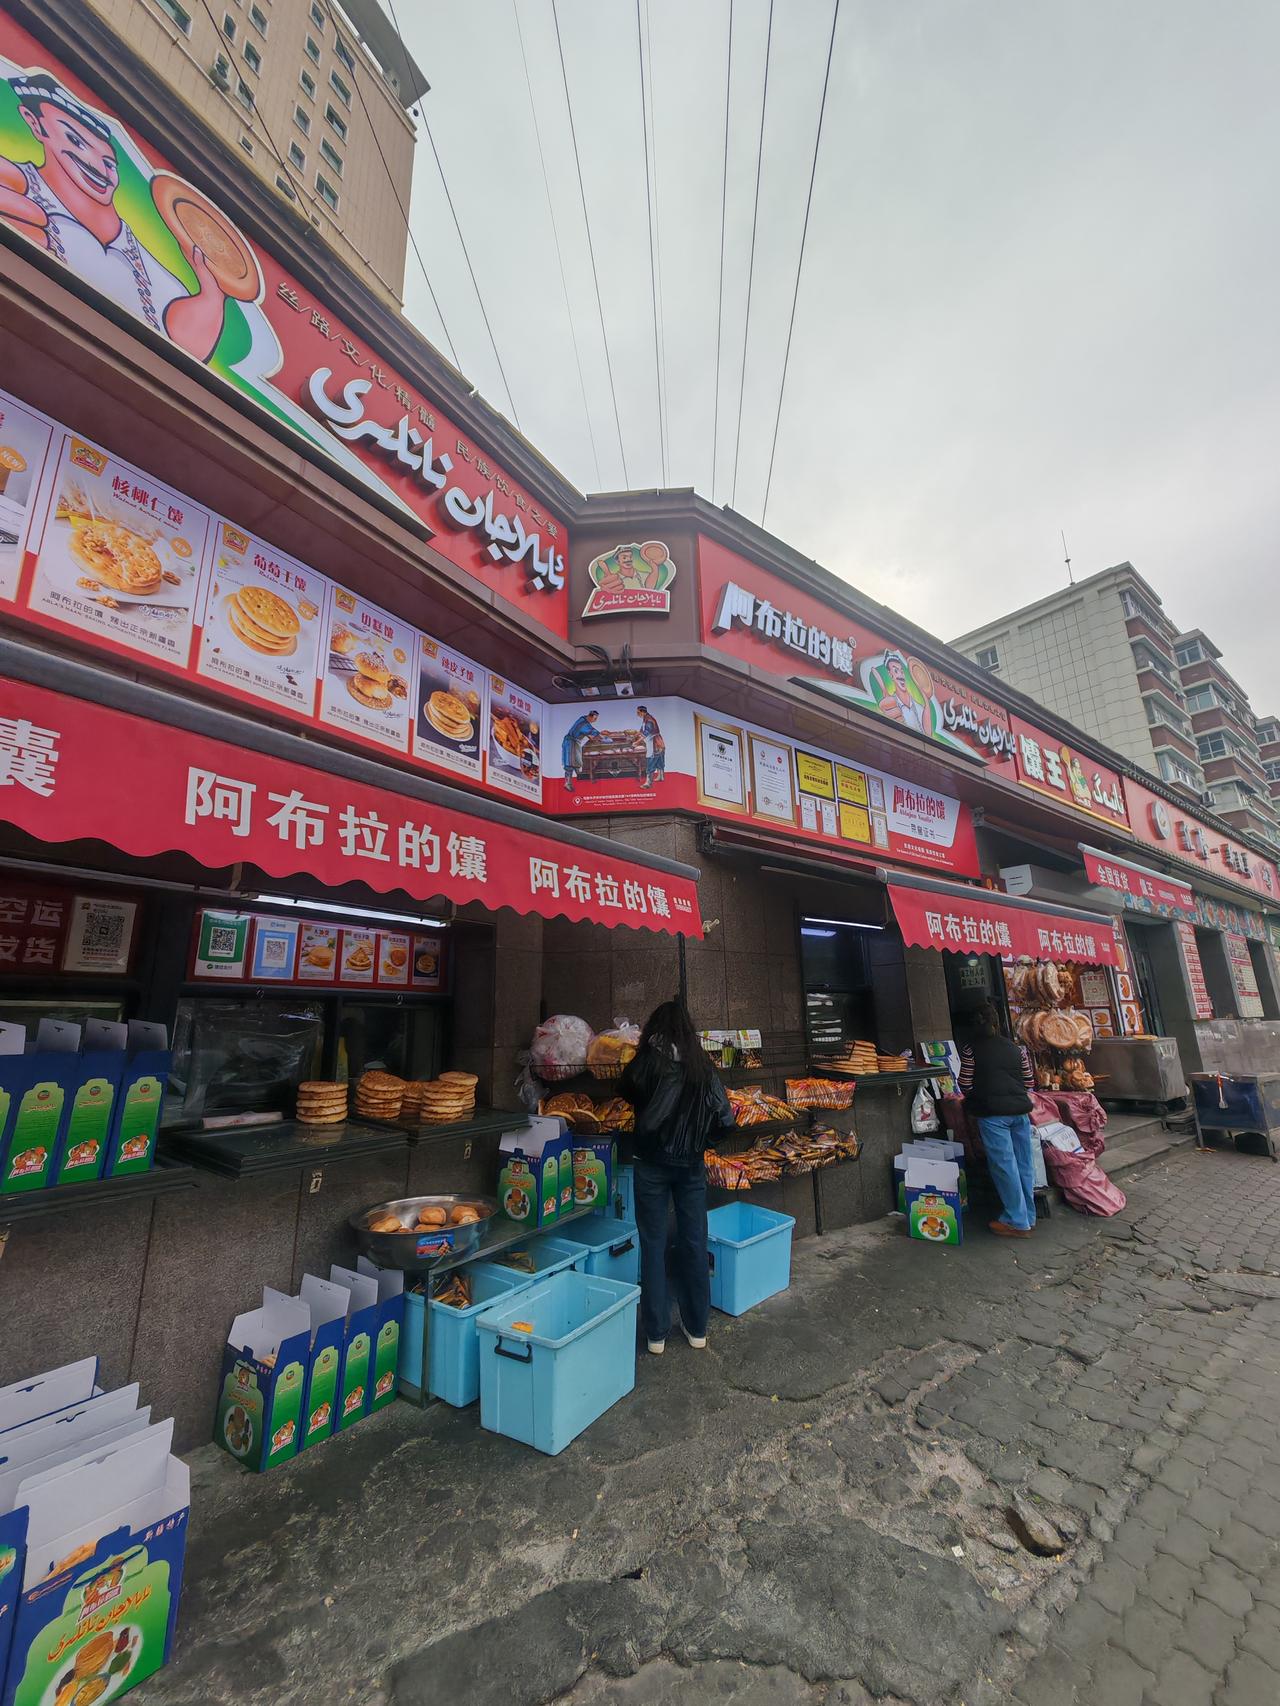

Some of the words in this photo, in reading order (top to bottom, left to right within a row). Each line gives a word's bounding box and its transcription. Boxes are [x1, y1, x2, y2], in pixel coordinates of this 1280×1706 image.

[718, 581, 854, 677] 阿布拉的馕
[185, 766, 488, 883] 阿布拉的馕
[893, 785, 945, 820] 阿布拉的馕
[530, 856, 671, 918] 阿布拉的馕
[1097, 864, 1130, 890] 全国发货
[925, 911, 1012, 948] 阿布拉的馕
[1037, 928, 1097, 958] 阿布拉的馕
